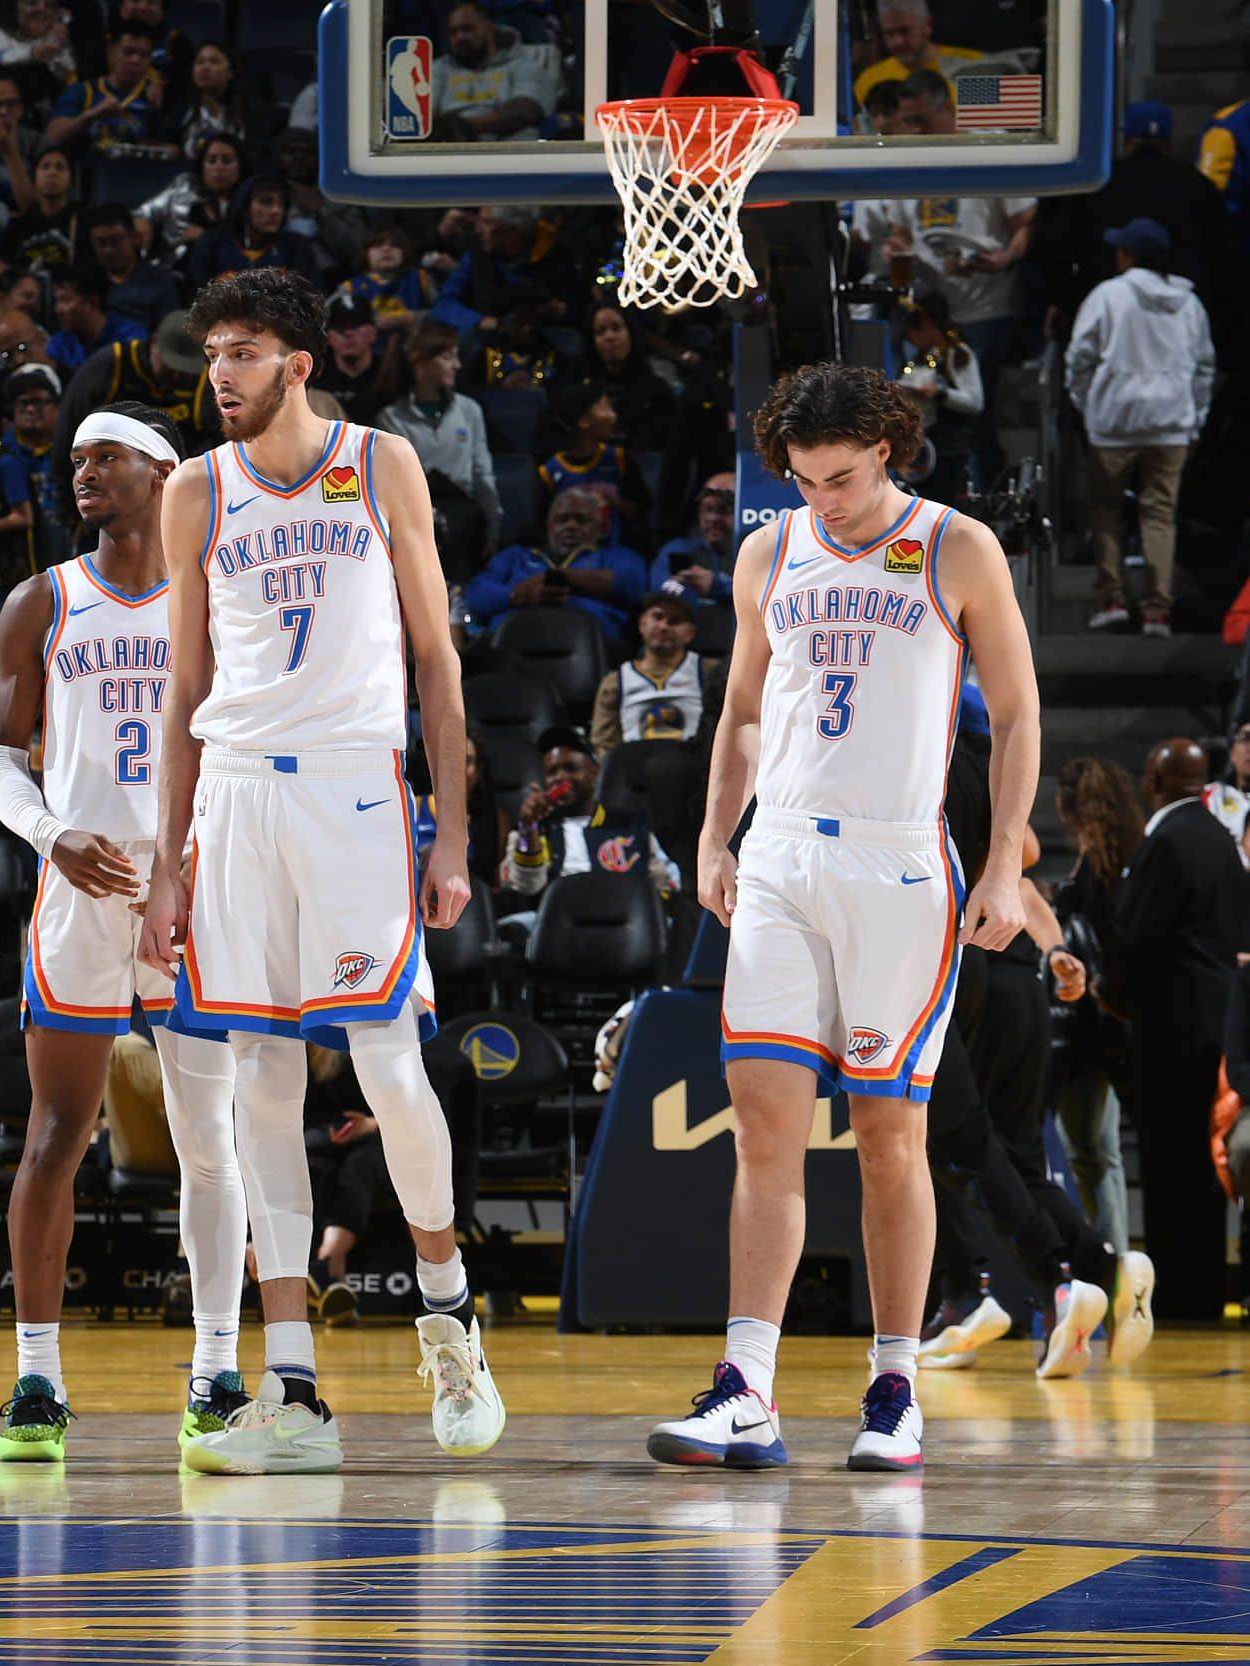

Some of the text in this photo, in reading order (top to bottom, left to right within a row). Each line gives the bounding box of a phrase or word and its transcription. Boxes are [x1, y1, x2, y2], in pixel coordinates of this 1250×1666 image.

[215, 520, 373, 577] OKLAHOMA
[262, 561, 326, 604] CITY
[771, 586, 928, 636] OKLAHOMA
[54, 637, 172, 682] OKLAHO
[279, 604, 315, 676] 7
[809, 631, 875, 666] CITY
[100, 678, 166, 713] CITY
[816, 671, 858, 740] 3
[115, 718, 151, 785] 2
